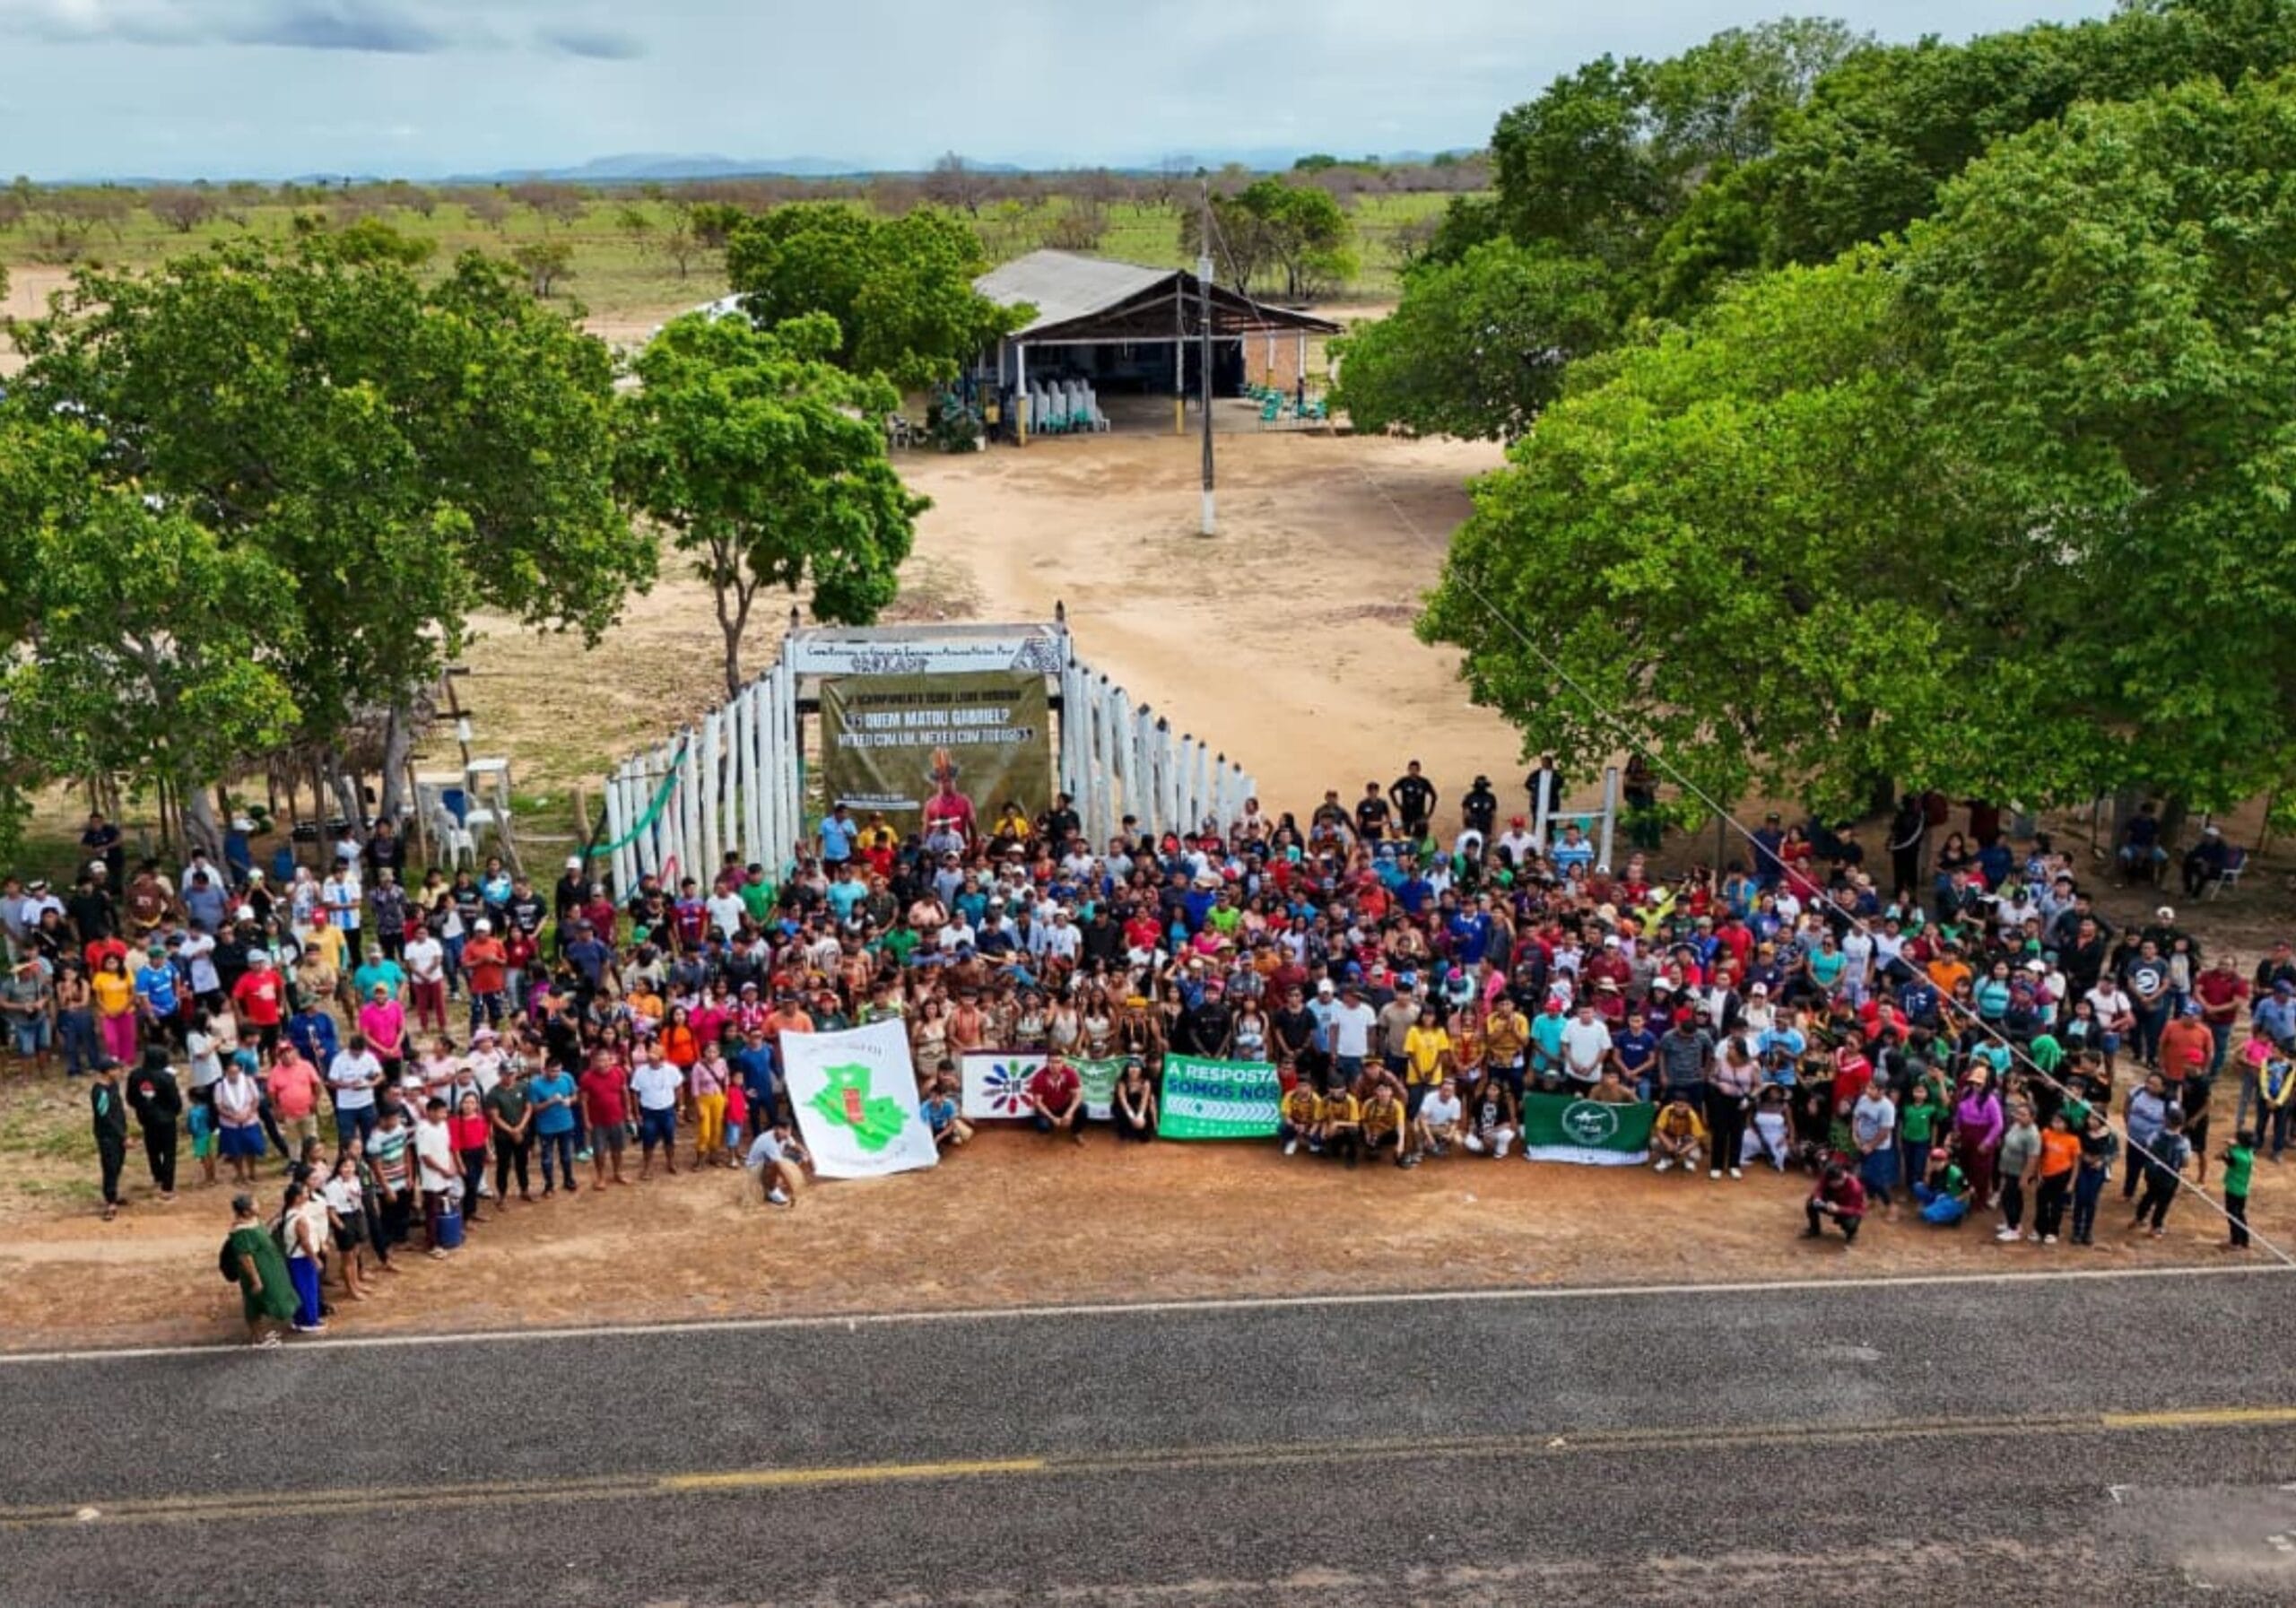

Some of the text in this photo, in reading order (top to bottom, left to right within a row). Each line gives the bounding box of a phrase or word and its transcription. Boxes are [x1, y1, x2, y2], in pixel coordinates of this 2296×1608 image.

[865, 712, 900, 728] QUEM
[905, 709, 947, 727] MATOU
[1168, 1061, 1280, 1085] A RESPOSTA
[1168, 1077, 1234, 1100] SOMOS
